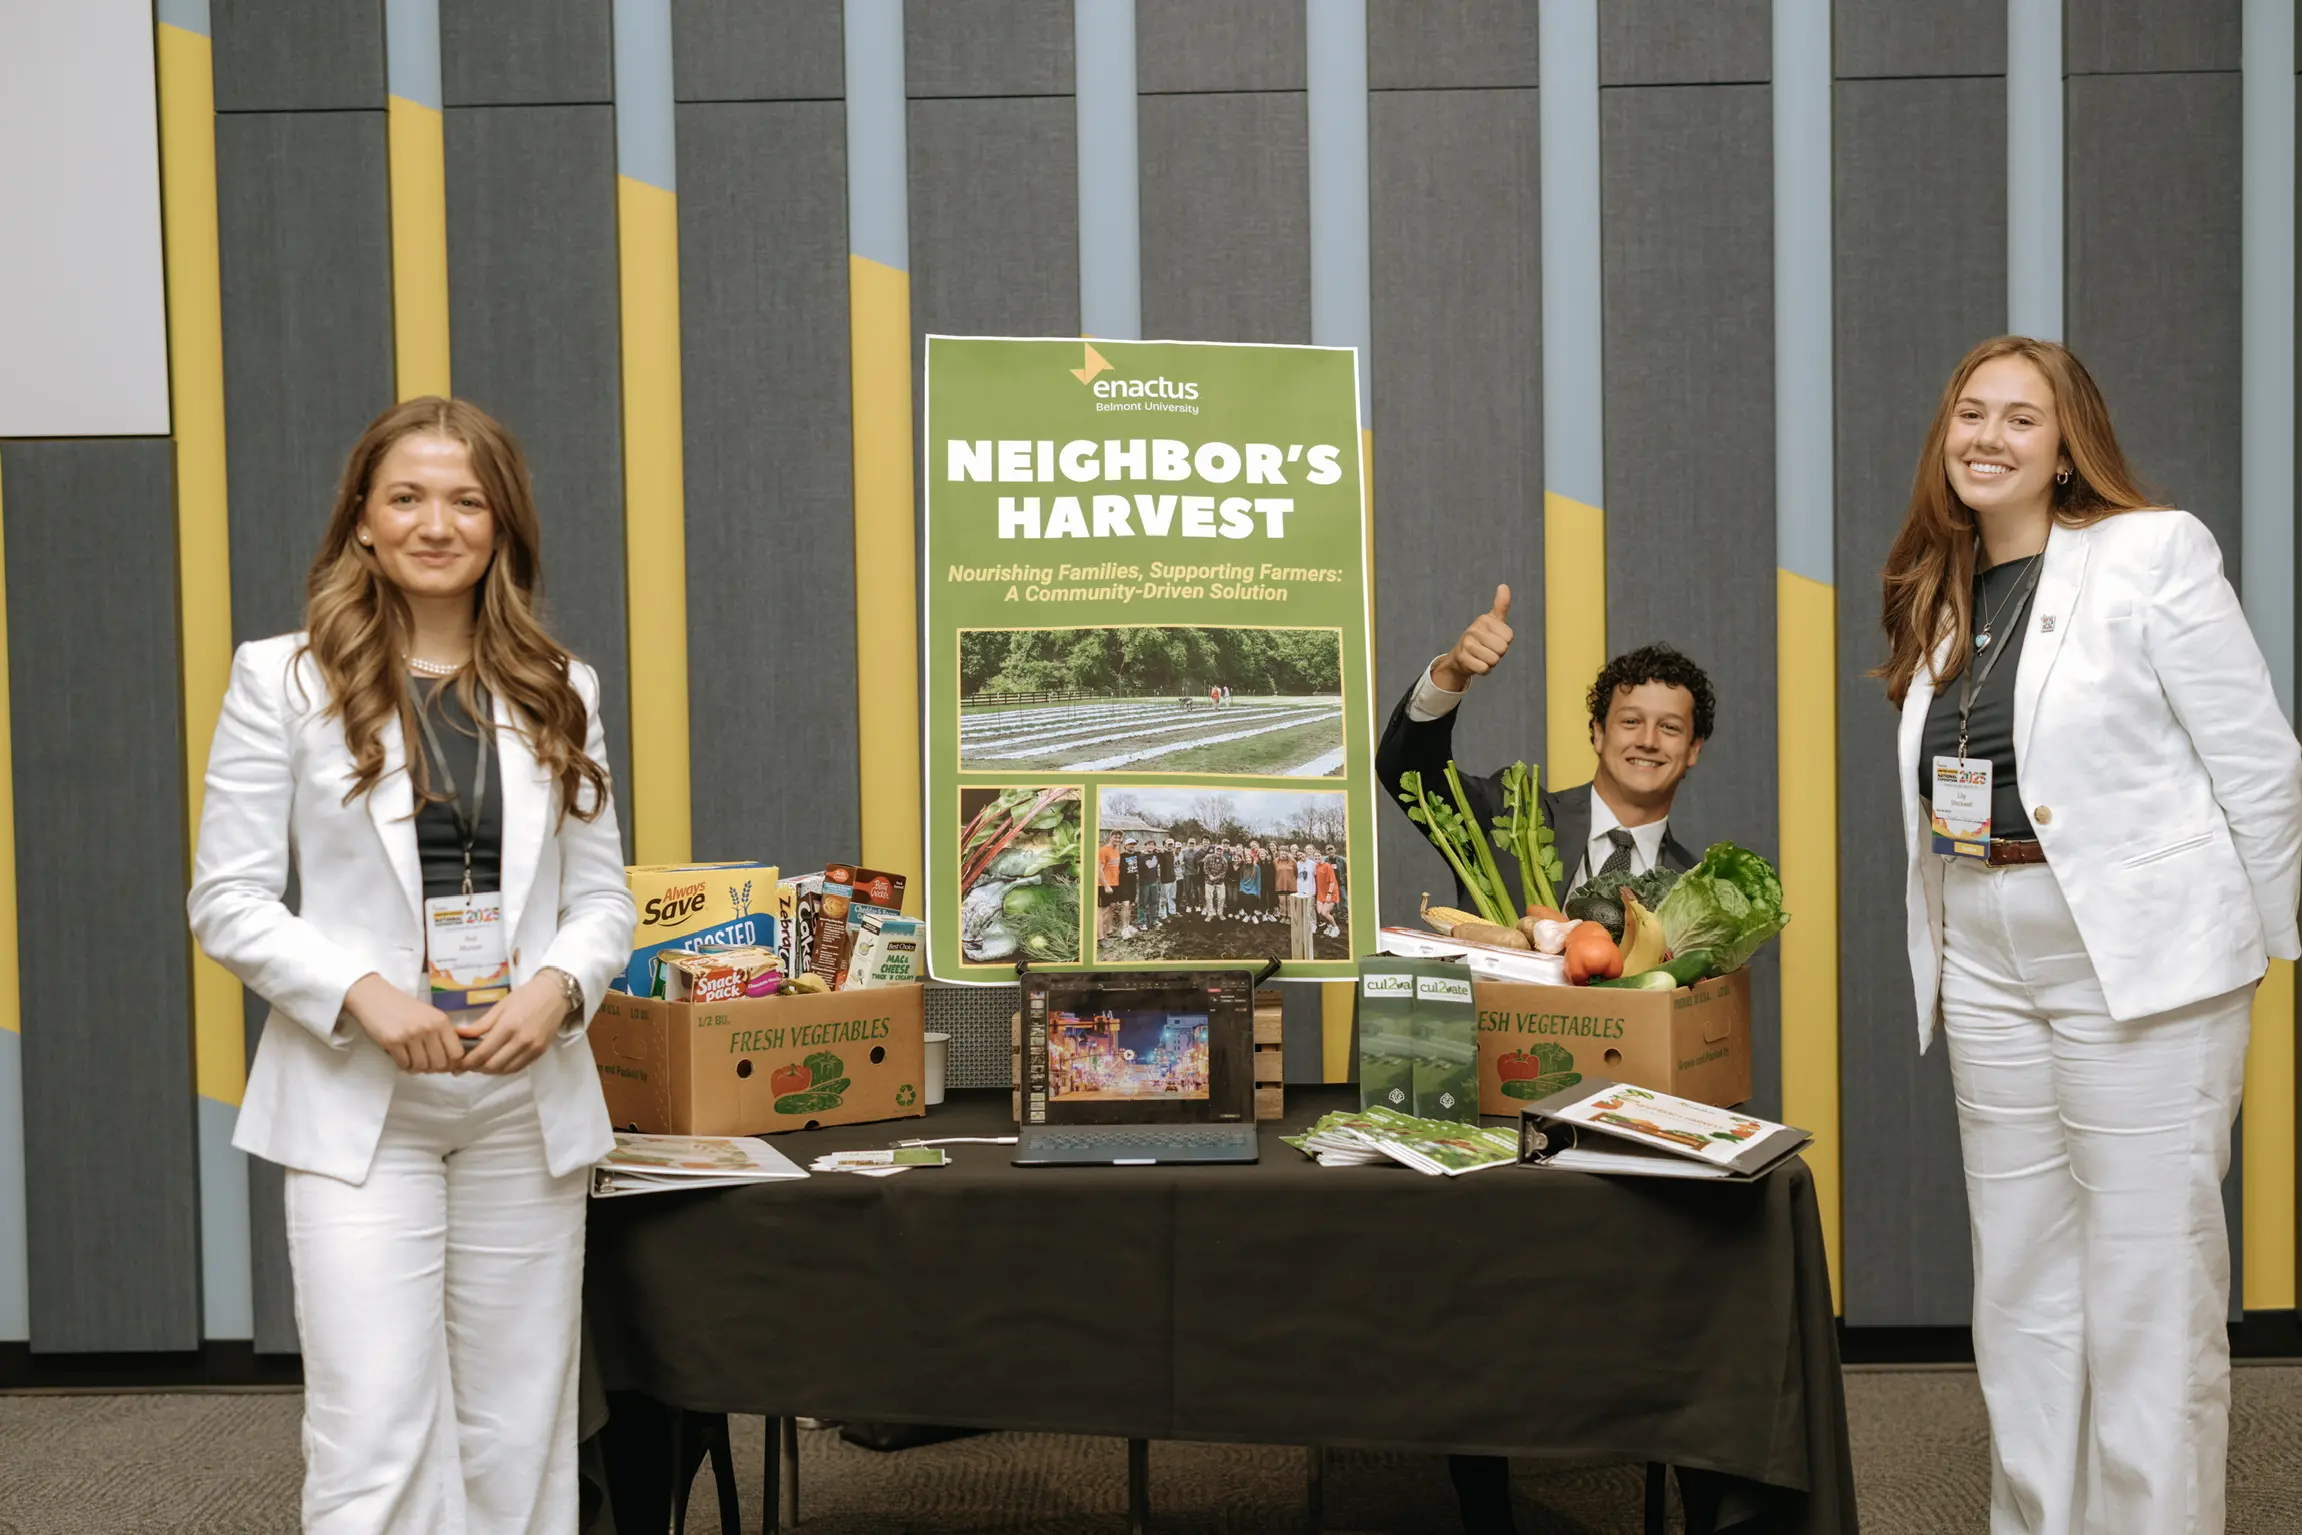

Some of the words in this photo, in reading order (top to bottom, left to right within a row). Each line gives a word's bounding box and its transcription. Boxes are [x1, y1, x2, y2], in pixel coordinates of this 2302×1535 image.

[1093, 376, 1199, 400] enactus
[1096, 402, 1142, 412] Belmont
[1144, 401, 1199, 415] University
[947, 439, 1342, 485] NEIGHBOR'S
[998, 494, 1294, 539] HARVEST
[948, 564, 1053, 585] Nourishing
[1058, 562, 1143, 581] Families,
[1150, 562, 1254, 583] Supporting
[1260, 563, 1343, 582] Farmers:
[1004, 585, 1019, 602] A
[1025, 582, 1204, 603] Community-Driven
[1209, 583, 1288, 601] Solution
[663, 881, 706, 903] Always
[642, 893, 705, 925] Save
[779, 895, 791, 948] Zebra
[880, 964, 910, 974] CHEESE
[697, 971, 741, 995] Snack
[706, 986, 740, 1002] pack
[1367, 977, 1412, 990] cul2va
[1420, 981, 1468, 996] cul2vate
[698, 1016, 712, 1027] 1/2
[715, 1015, 730, 1025] BU.
[1478, 1011, 1510, 1032] ESH
[1516, 1013, 1625, 1039] VEGETABLES
[730, 1028, 785, 1053] FRESH
[790, 1017, 891, 1048] VEGETABLES
